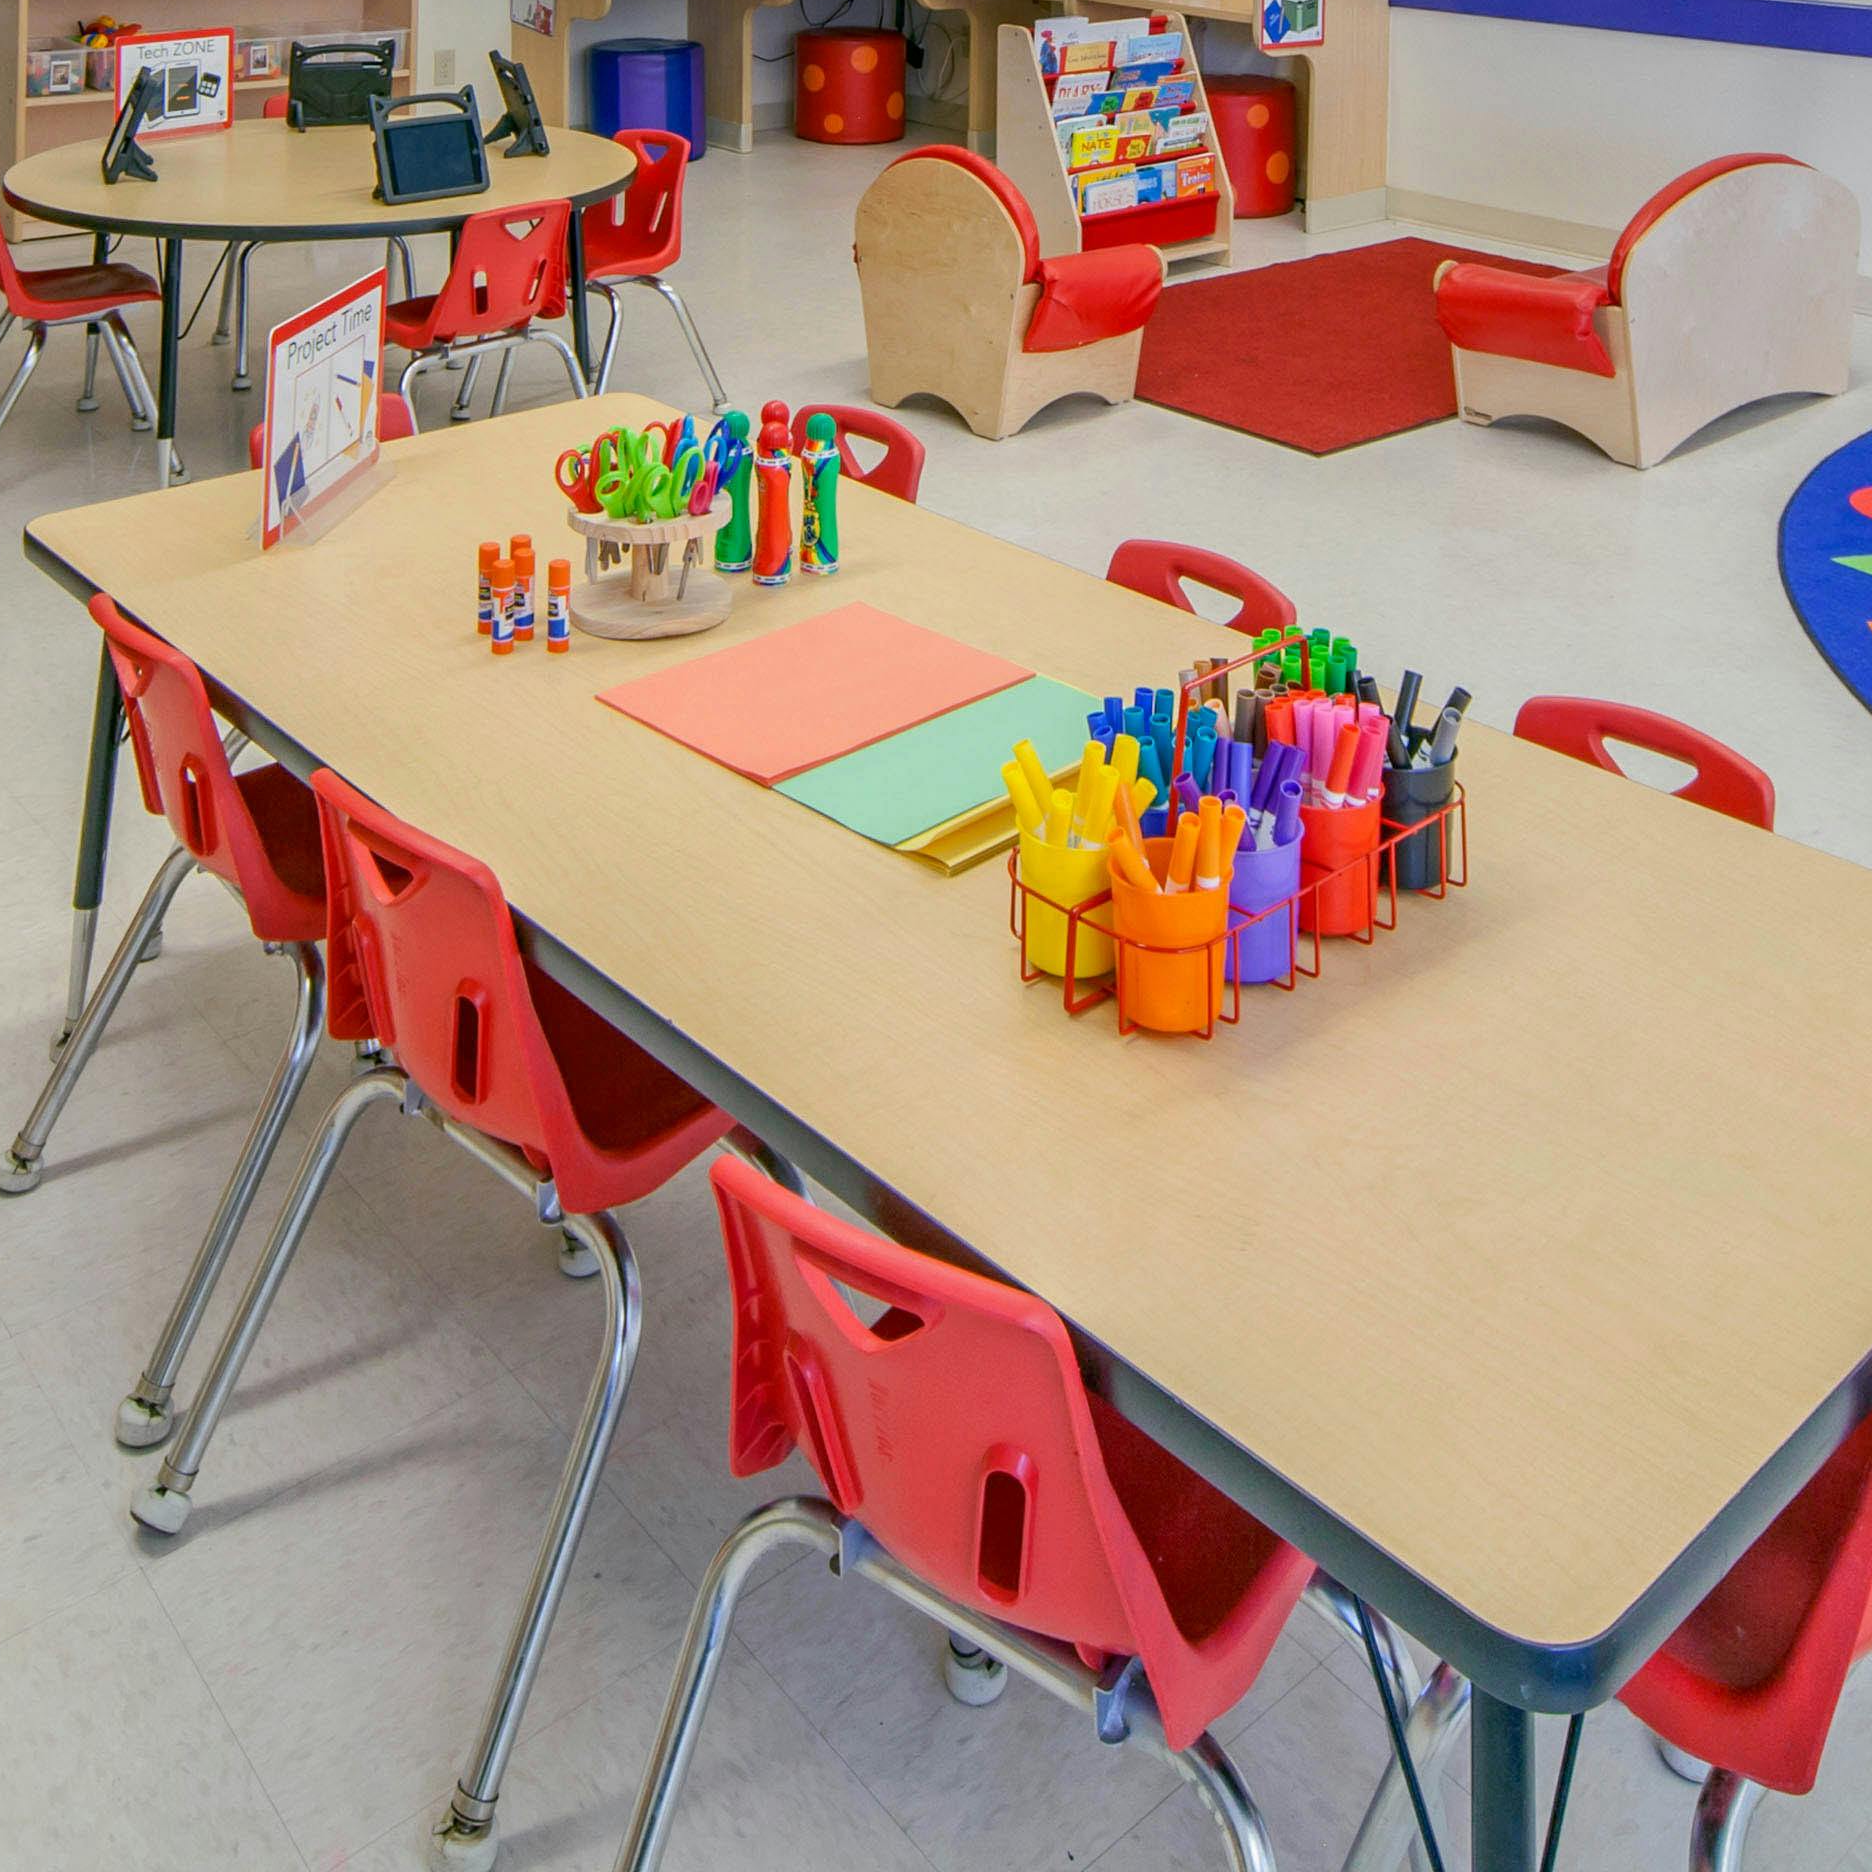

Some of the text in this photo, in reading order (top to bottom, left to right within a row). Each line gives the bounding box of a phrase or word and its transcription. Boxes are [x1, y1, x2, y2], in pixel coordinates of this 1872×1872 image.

[135, 39, 216, 60] Tech ZONE
[1081, 138, 1112, 151] NATE
[288, 304, 372, 370] Project Time
